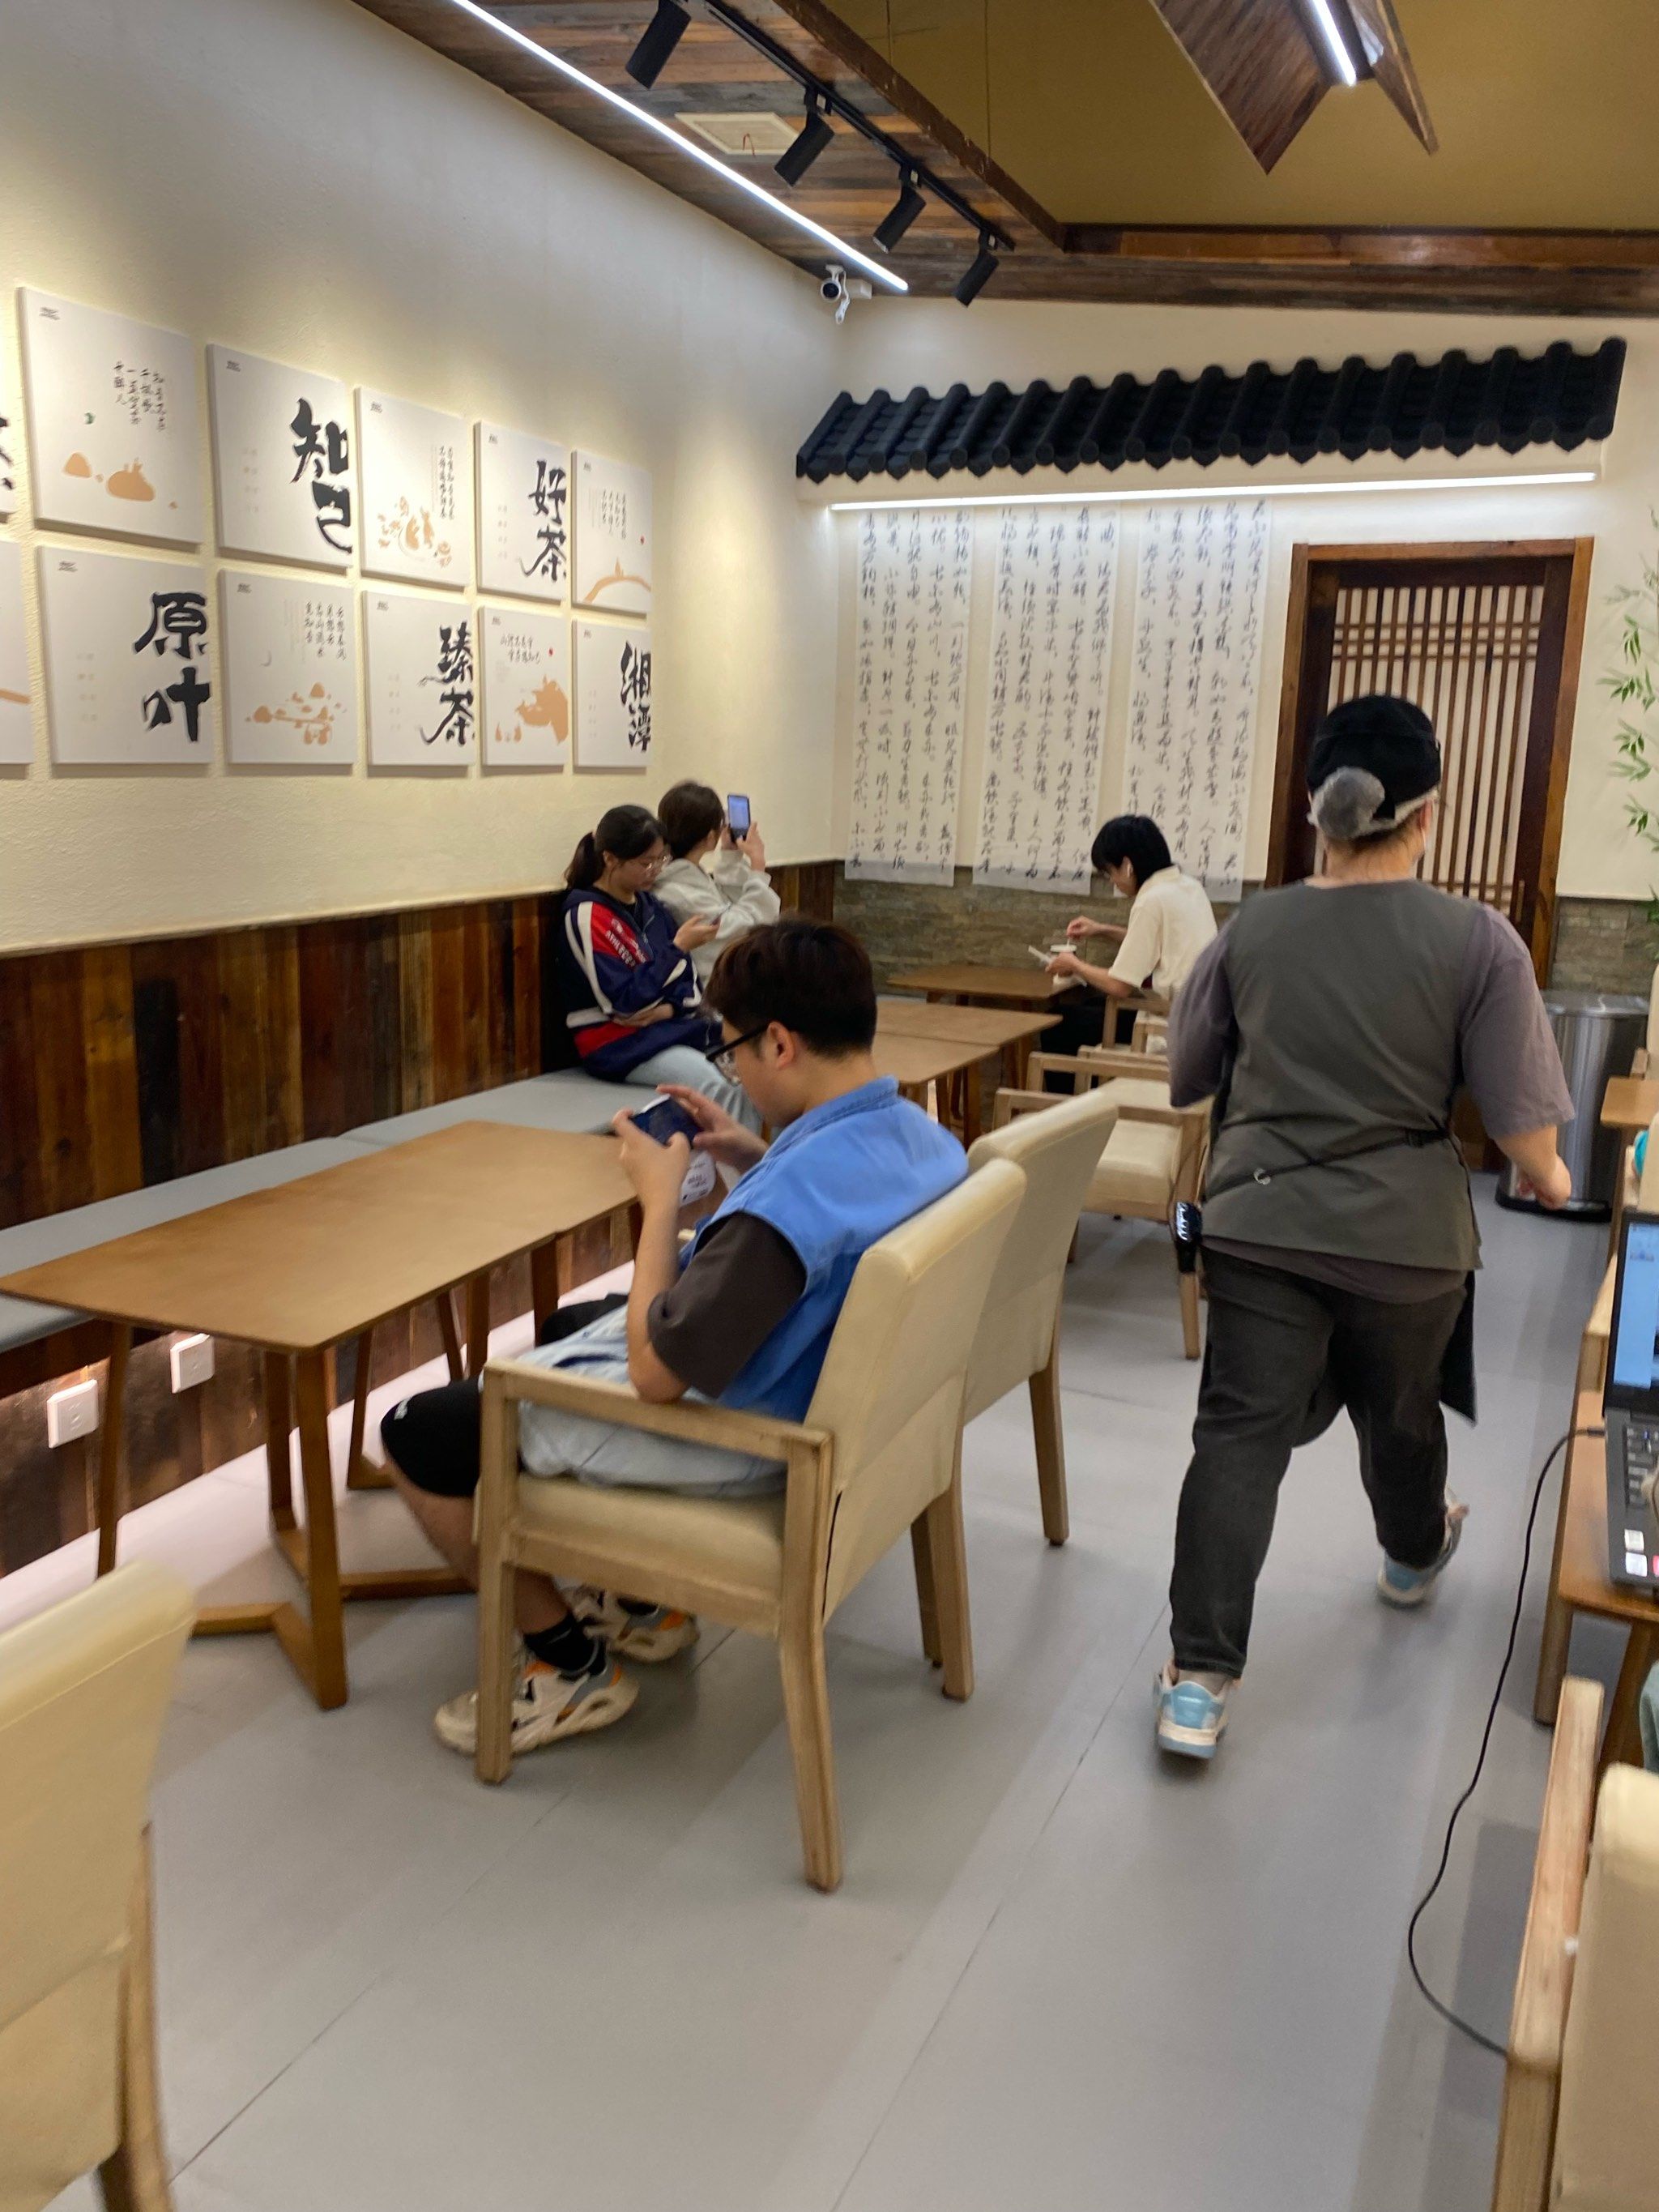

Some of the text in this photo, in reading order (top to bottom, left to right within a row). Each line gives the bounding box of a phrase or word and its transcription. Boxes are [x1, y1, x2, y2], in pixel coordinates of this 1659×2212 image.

[290, 398, 353, 554] 知己
[520, 459, 566, 582] 好茶
[133, 591, 211, 743] 原叶
